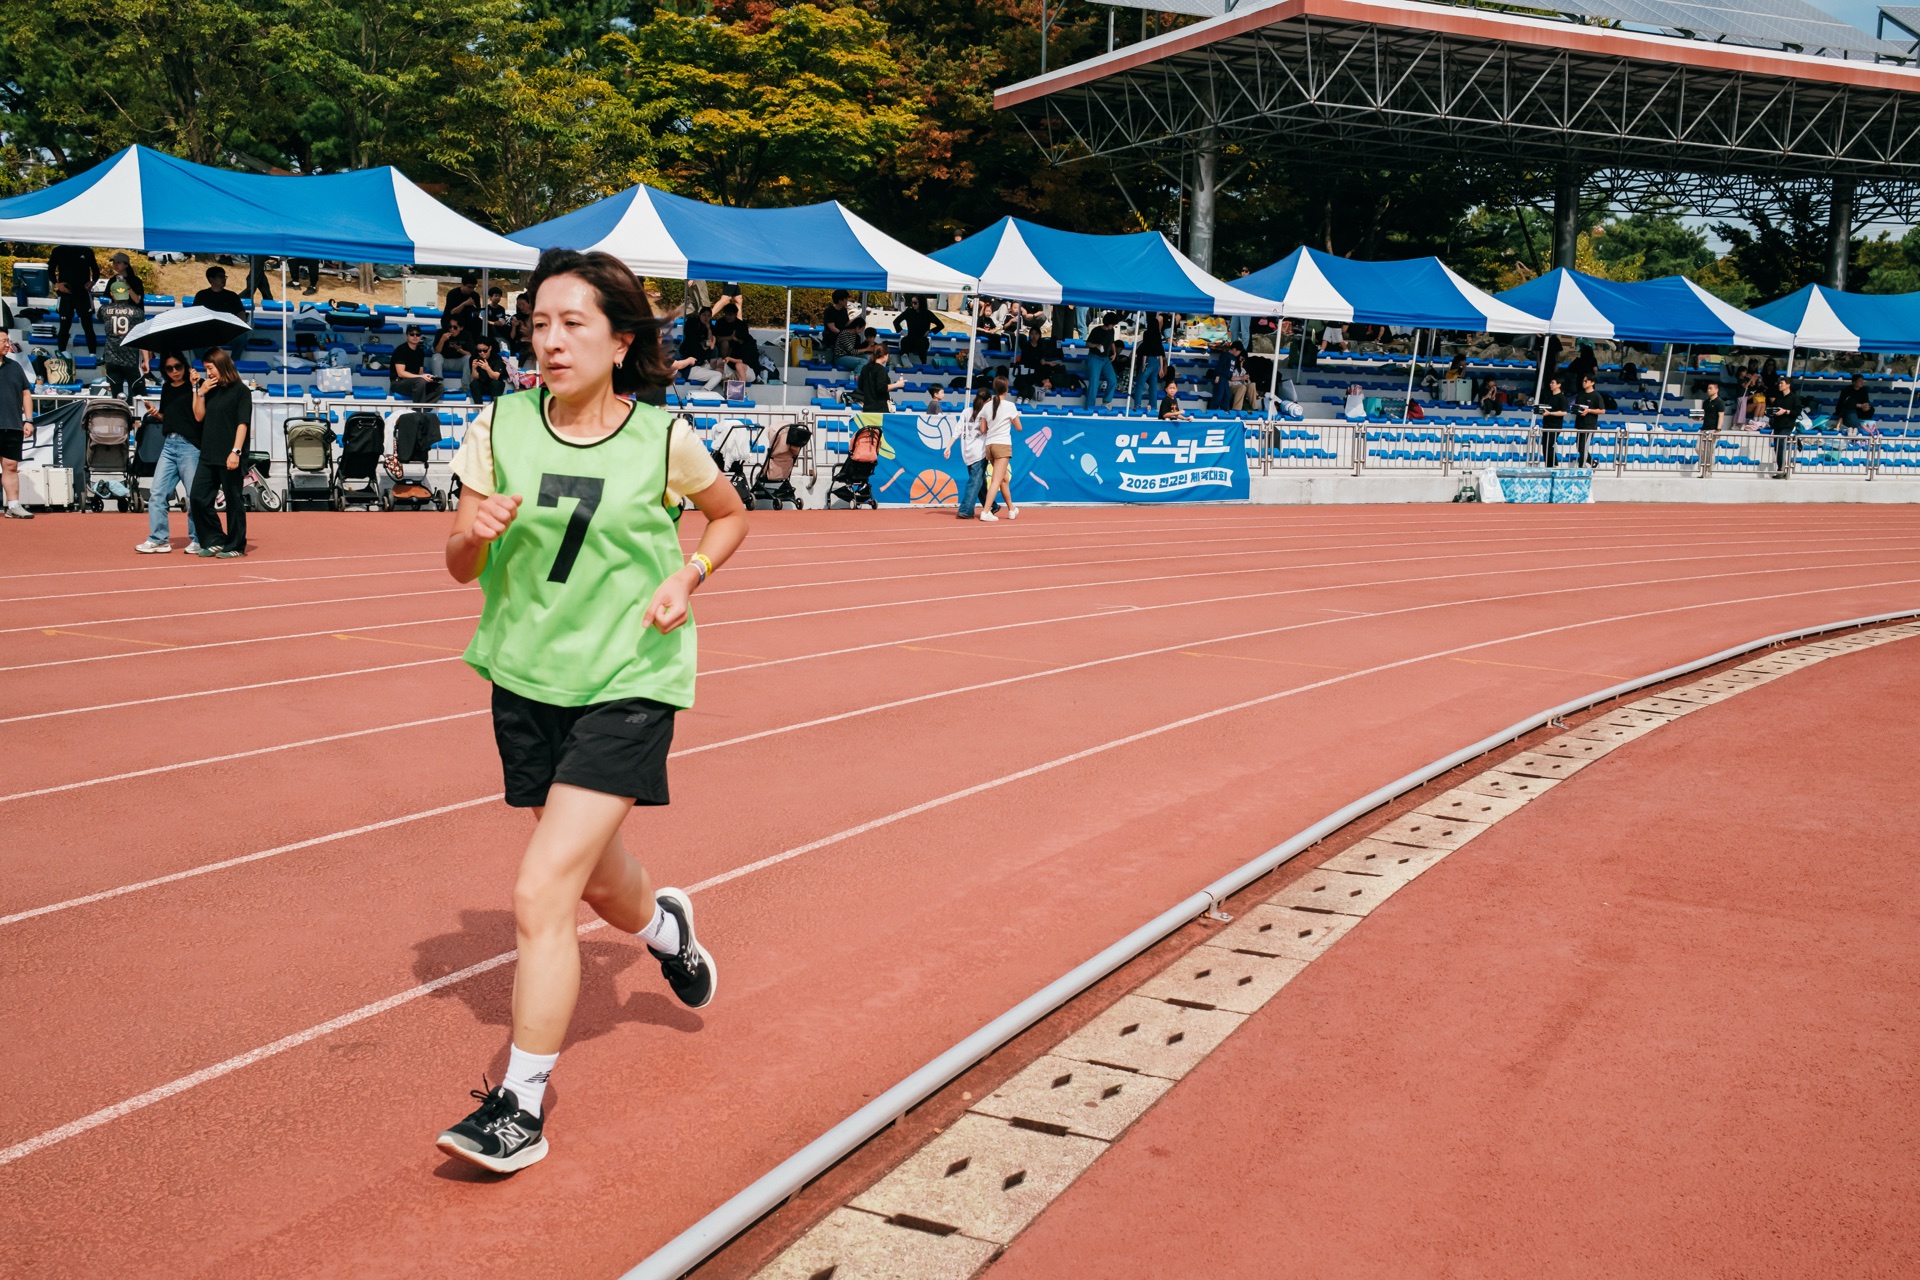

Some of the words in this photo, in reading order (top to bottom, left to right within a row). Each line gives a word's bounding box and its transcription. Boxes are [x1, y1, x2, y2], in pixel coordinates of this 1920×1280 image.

[111, 316, 129, 334] 19
[1126, 478, 1156, 489] 2026
[1158, 474, 1188, 488] 전교인
[1190, 470, 1228, 484] 체육대회
[536, 473, 605, 584] 7
[494, 1122, 530, 1149] N
